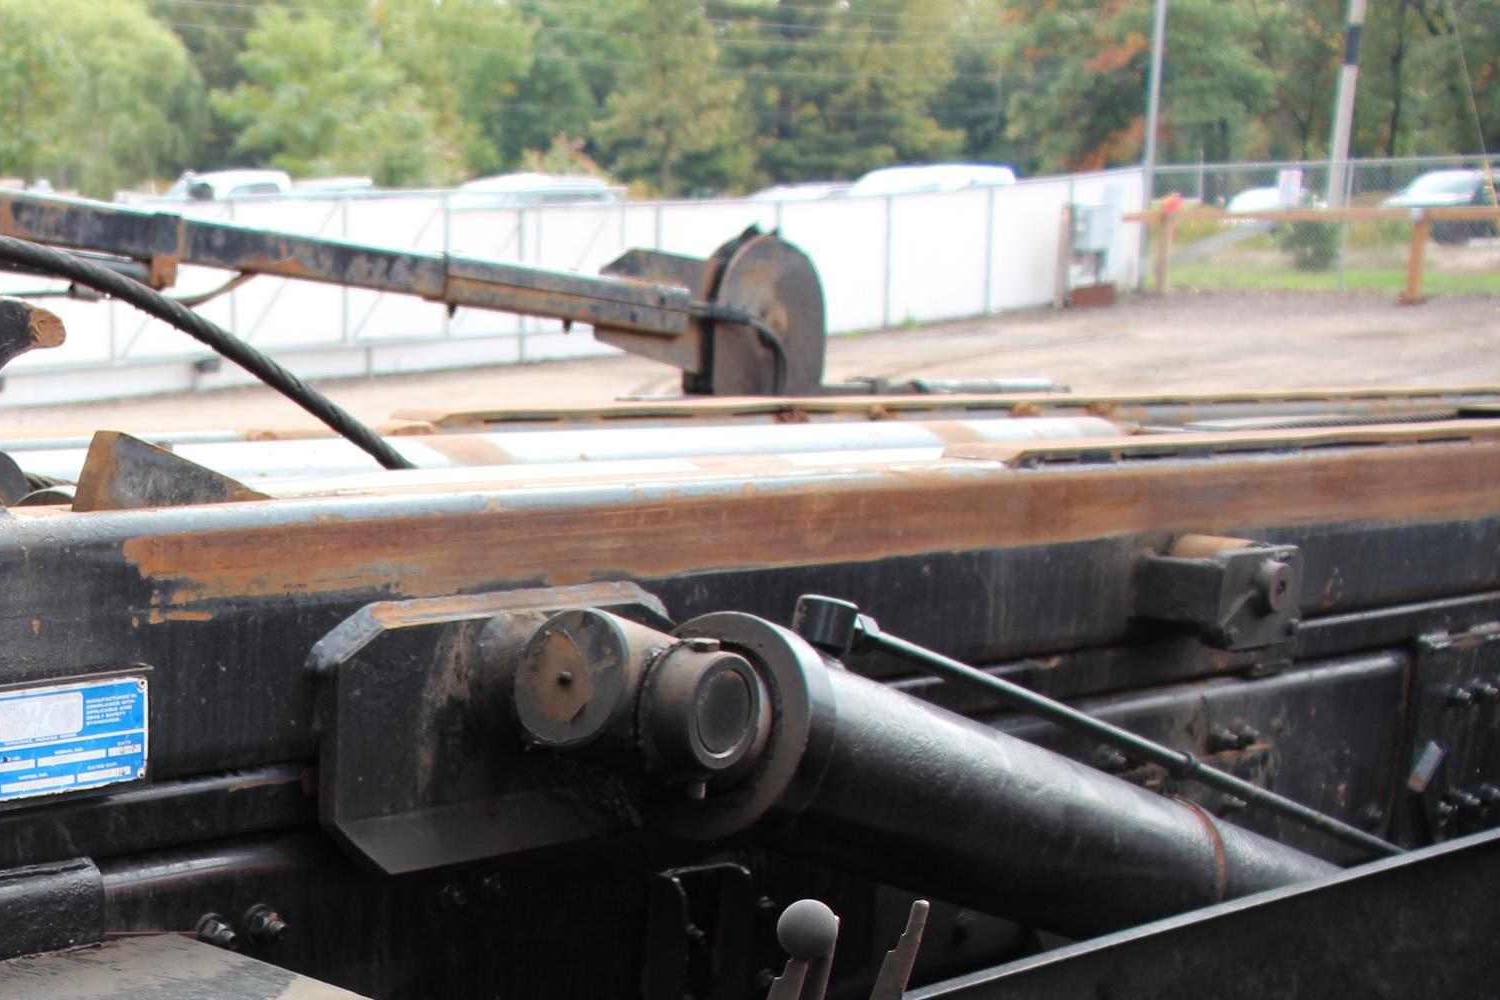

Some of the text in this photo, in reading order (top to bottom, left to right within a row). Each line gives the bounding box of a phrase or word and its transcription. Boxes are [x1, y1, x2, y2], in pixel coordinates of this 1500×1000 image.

[86, 695, 129, 704] MANUFACTURED
[86, 701, 120, 709] COMPLIANCE
[86, 707, 118, 715] APPLICABLE
